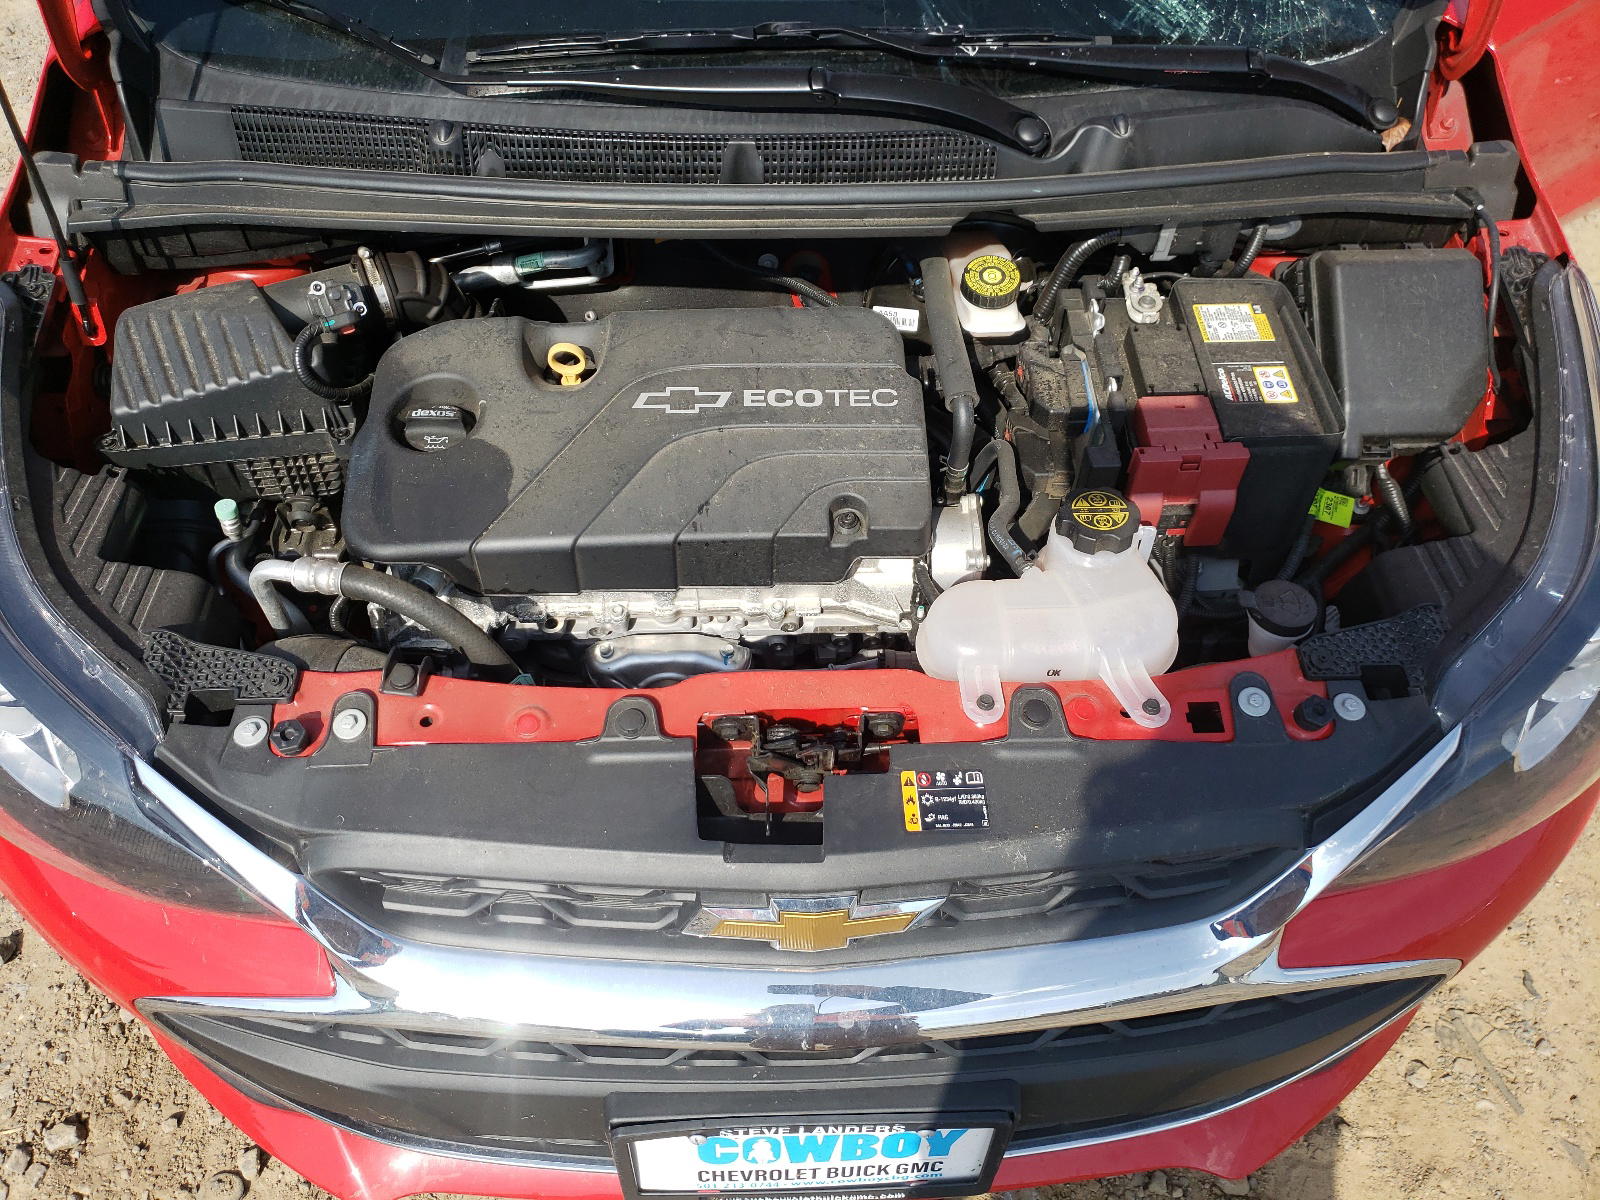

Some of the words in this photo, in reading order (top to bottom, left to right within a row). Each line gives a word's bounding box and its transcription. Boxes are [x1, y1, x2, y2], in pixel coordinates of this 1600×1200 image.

[743, 388, 899, 407] ECOTEC
[412, 409, 455, 417] dexos
[720, 1127, 791, 1136] STEVE
[800, 1124, 906, 1134] LANDERS
[698, 1128, 968, 1164] COWBOY
[697, 1167, 821, 1182] CHEVROLET
[826, 1164, 891, 1179] BUICK
[895, 1161, 944, 1174] GMC
